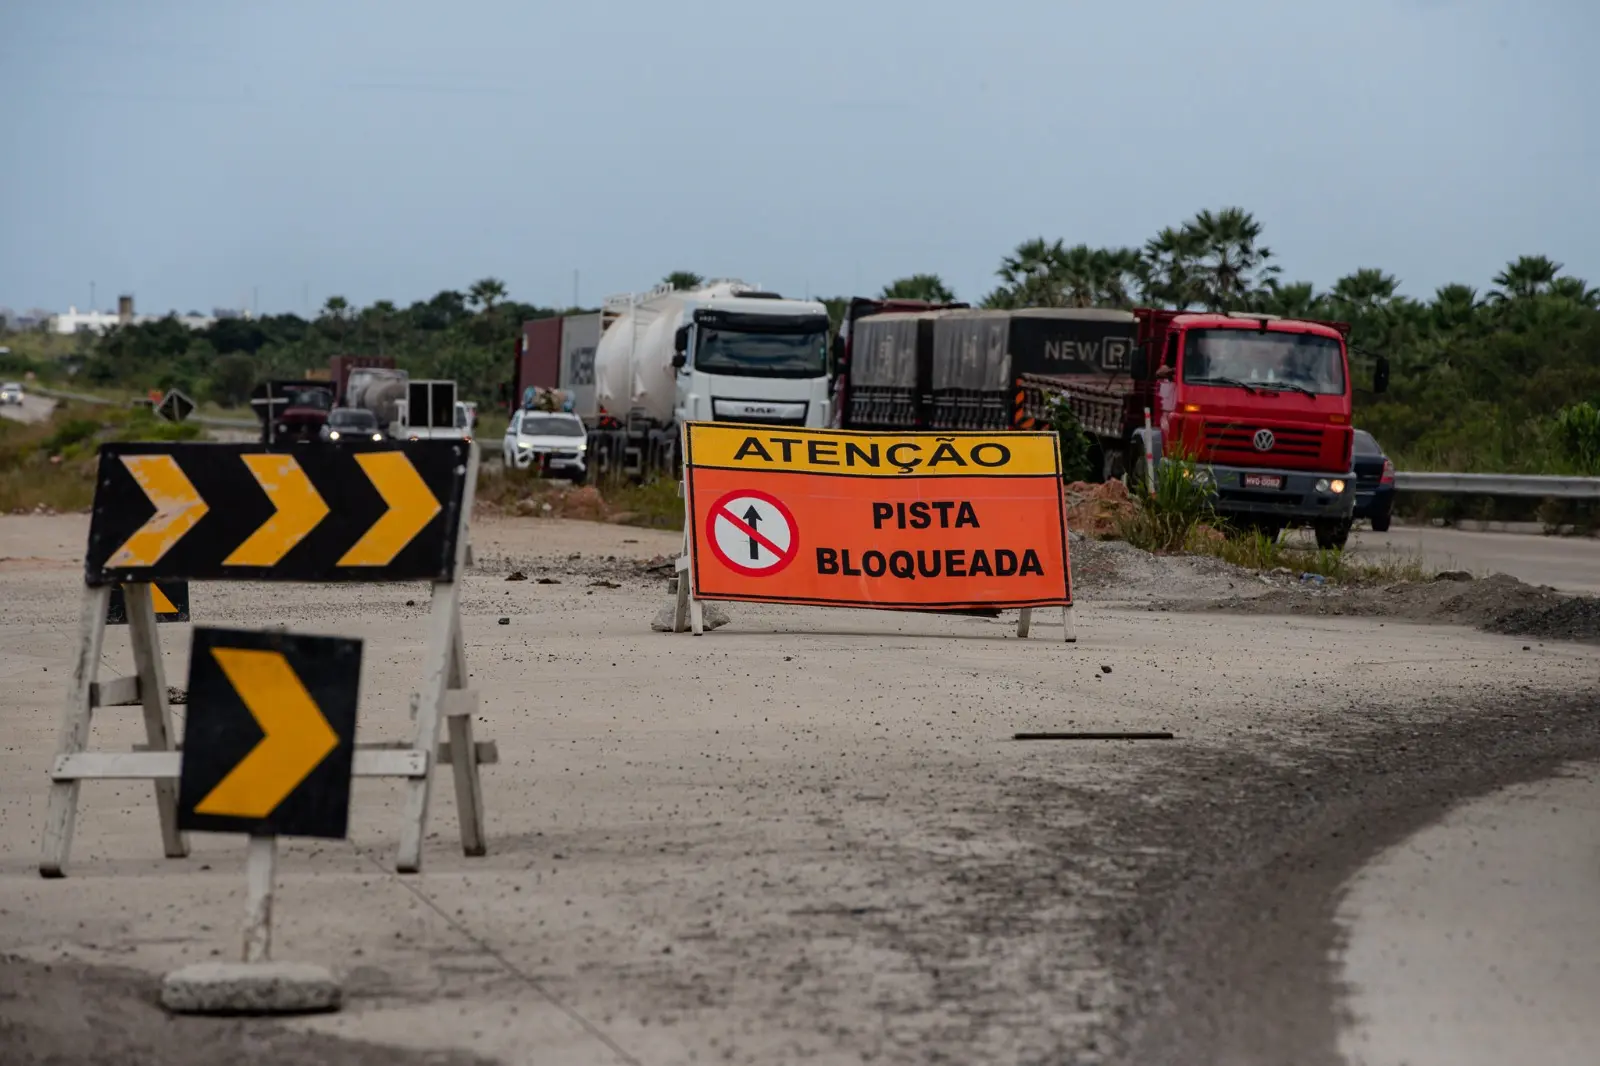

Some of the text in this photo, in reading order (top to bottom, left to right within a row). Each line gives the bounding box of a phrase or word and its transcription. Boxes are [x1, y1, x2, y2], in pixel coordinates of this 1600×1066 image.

[1044, 340, 1099, 361] NEW
[733, 437, 1011, 474] ATENÇÃO
[872, 501, 981, 529] PISTA
[816, 547, 1044, 580] BLOQUEADA
